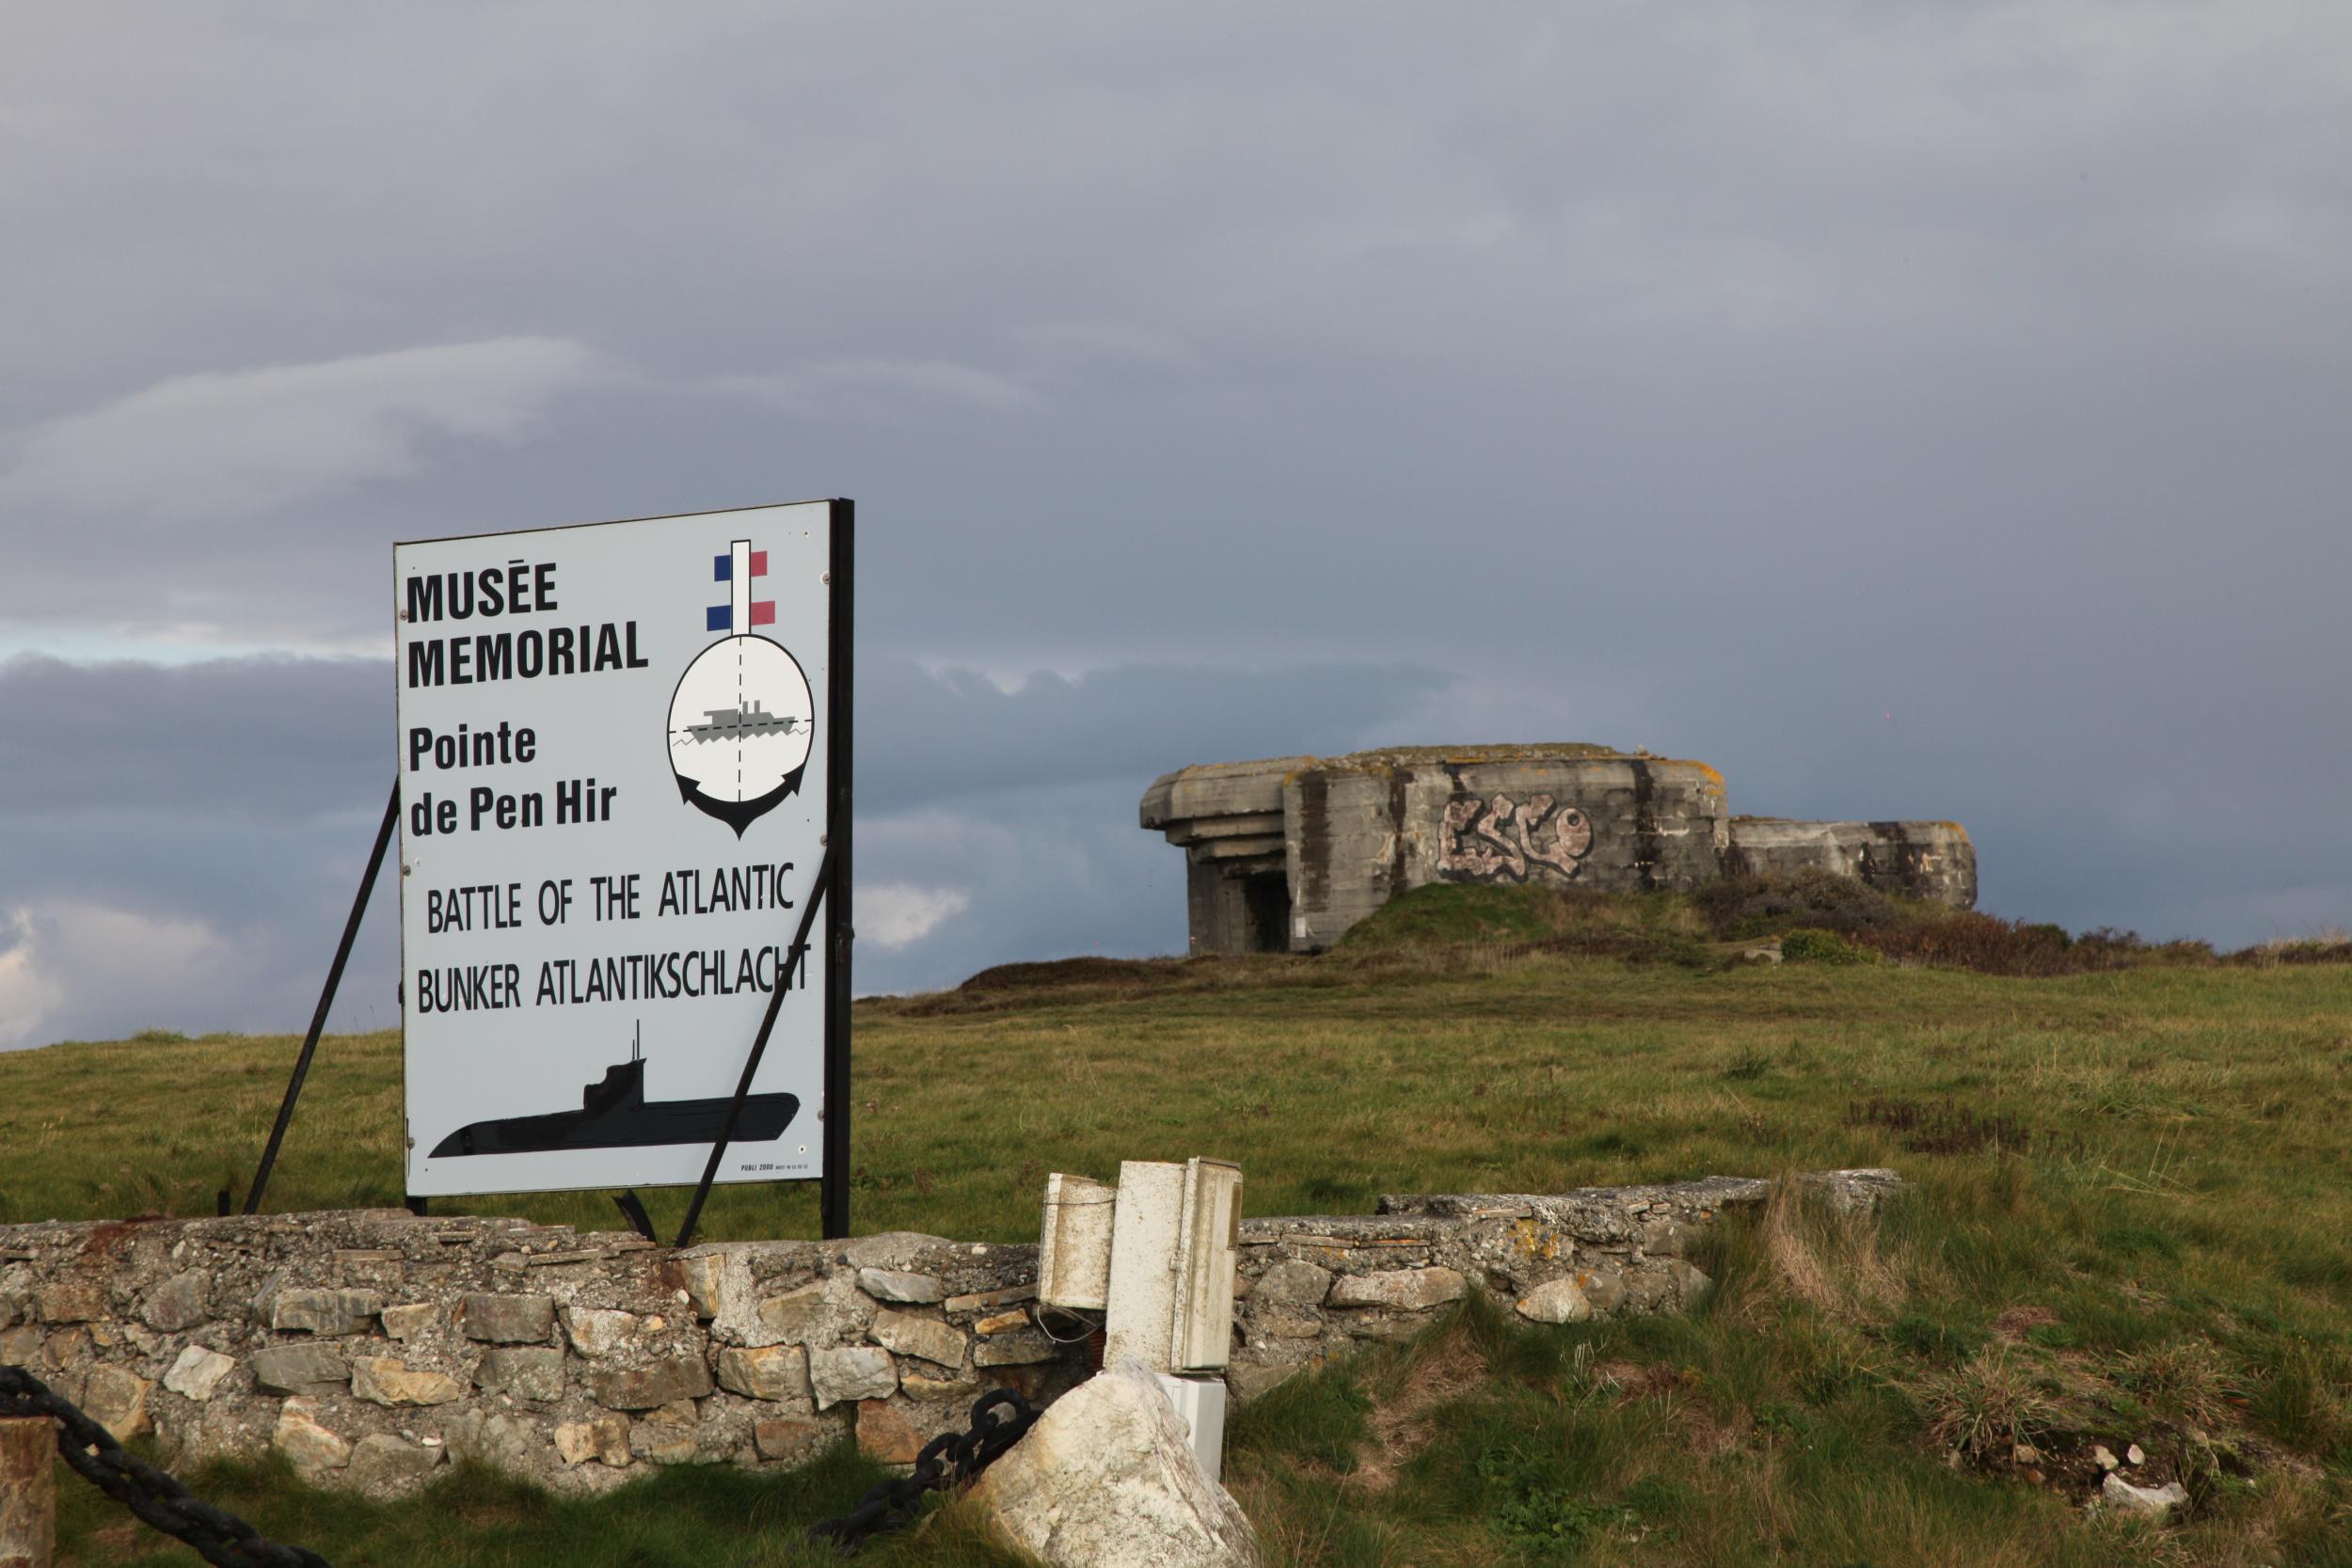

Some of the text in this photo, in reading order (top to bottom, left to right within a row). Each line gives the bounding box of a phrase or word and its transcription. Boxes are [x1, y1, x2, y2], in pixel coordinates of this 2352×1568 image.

[408, 620, 649, 689] MEMORIAL
[409, 721, 536, 772] Pointe
[410, 777, 617, 837] de Pen Hir
[427, 862, 794, 934] BATTLE OF THE ATLANTIC
[418, 963, 521, 1014] BUNKER
